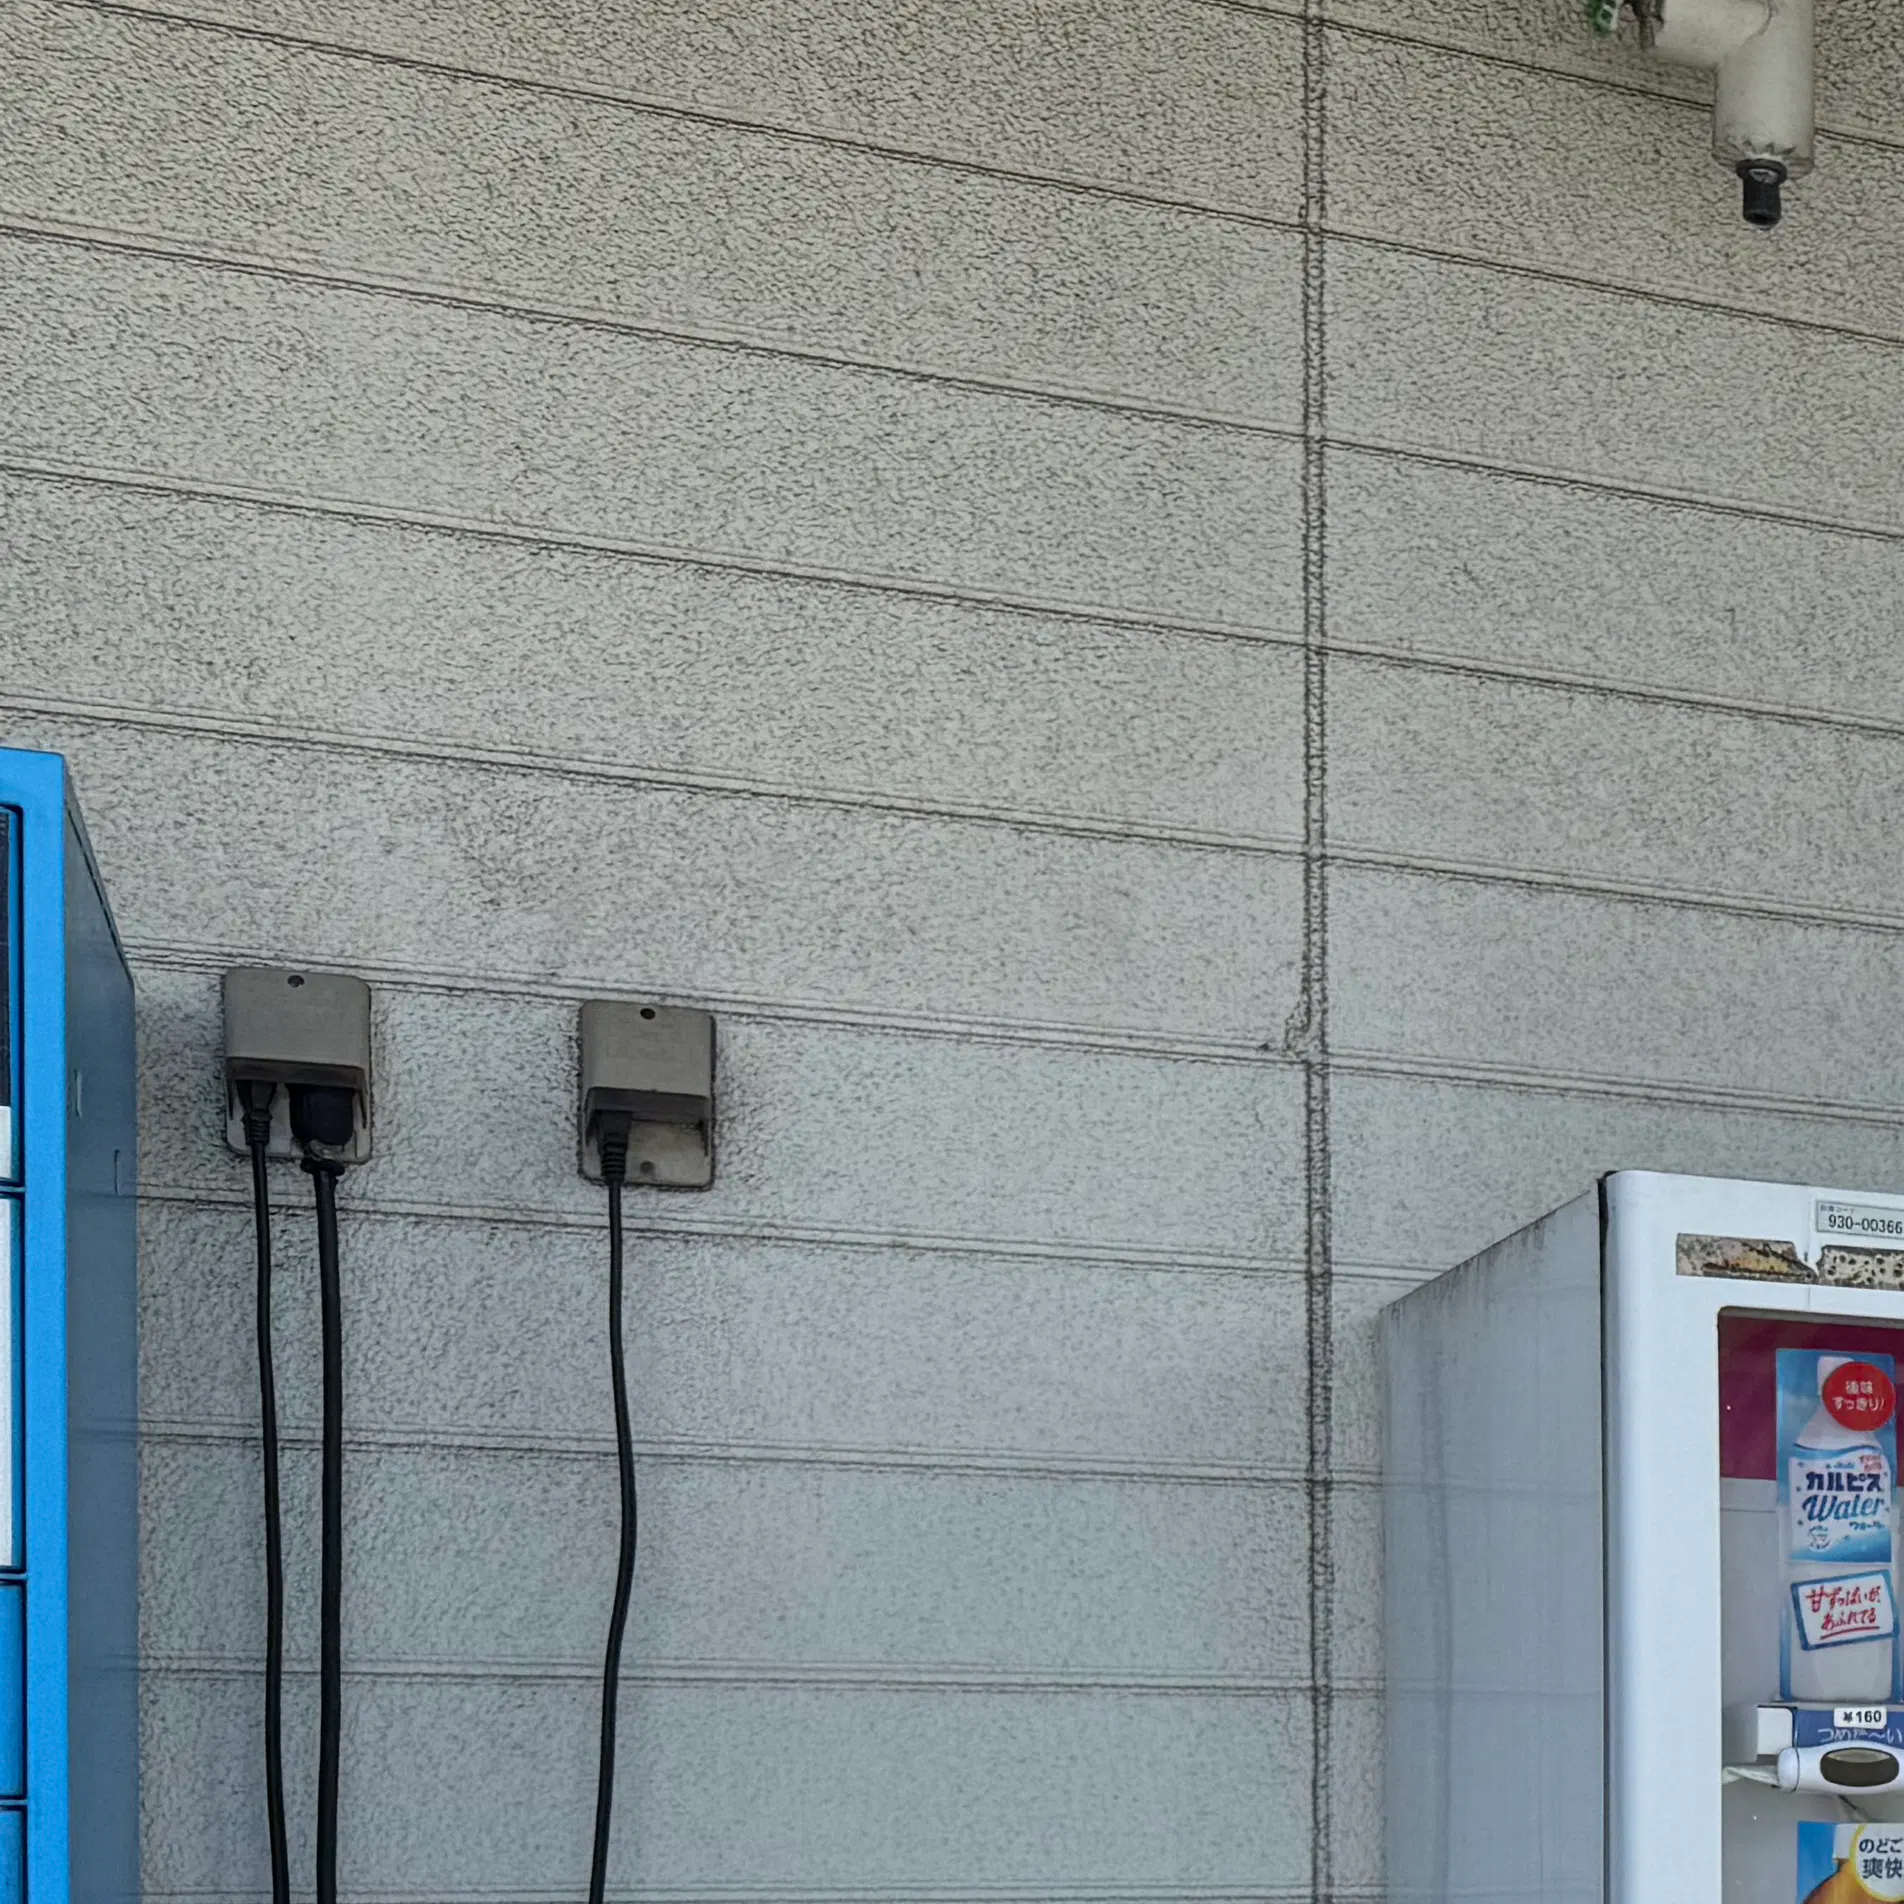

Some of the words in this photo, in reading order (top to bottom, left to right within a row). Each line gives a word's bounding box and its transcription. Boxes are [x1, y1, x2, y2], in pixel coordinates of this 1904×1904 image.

[1805, 1471, 1882, 1492] カルピス
[1801, 1493, 1885, 1522] Water
